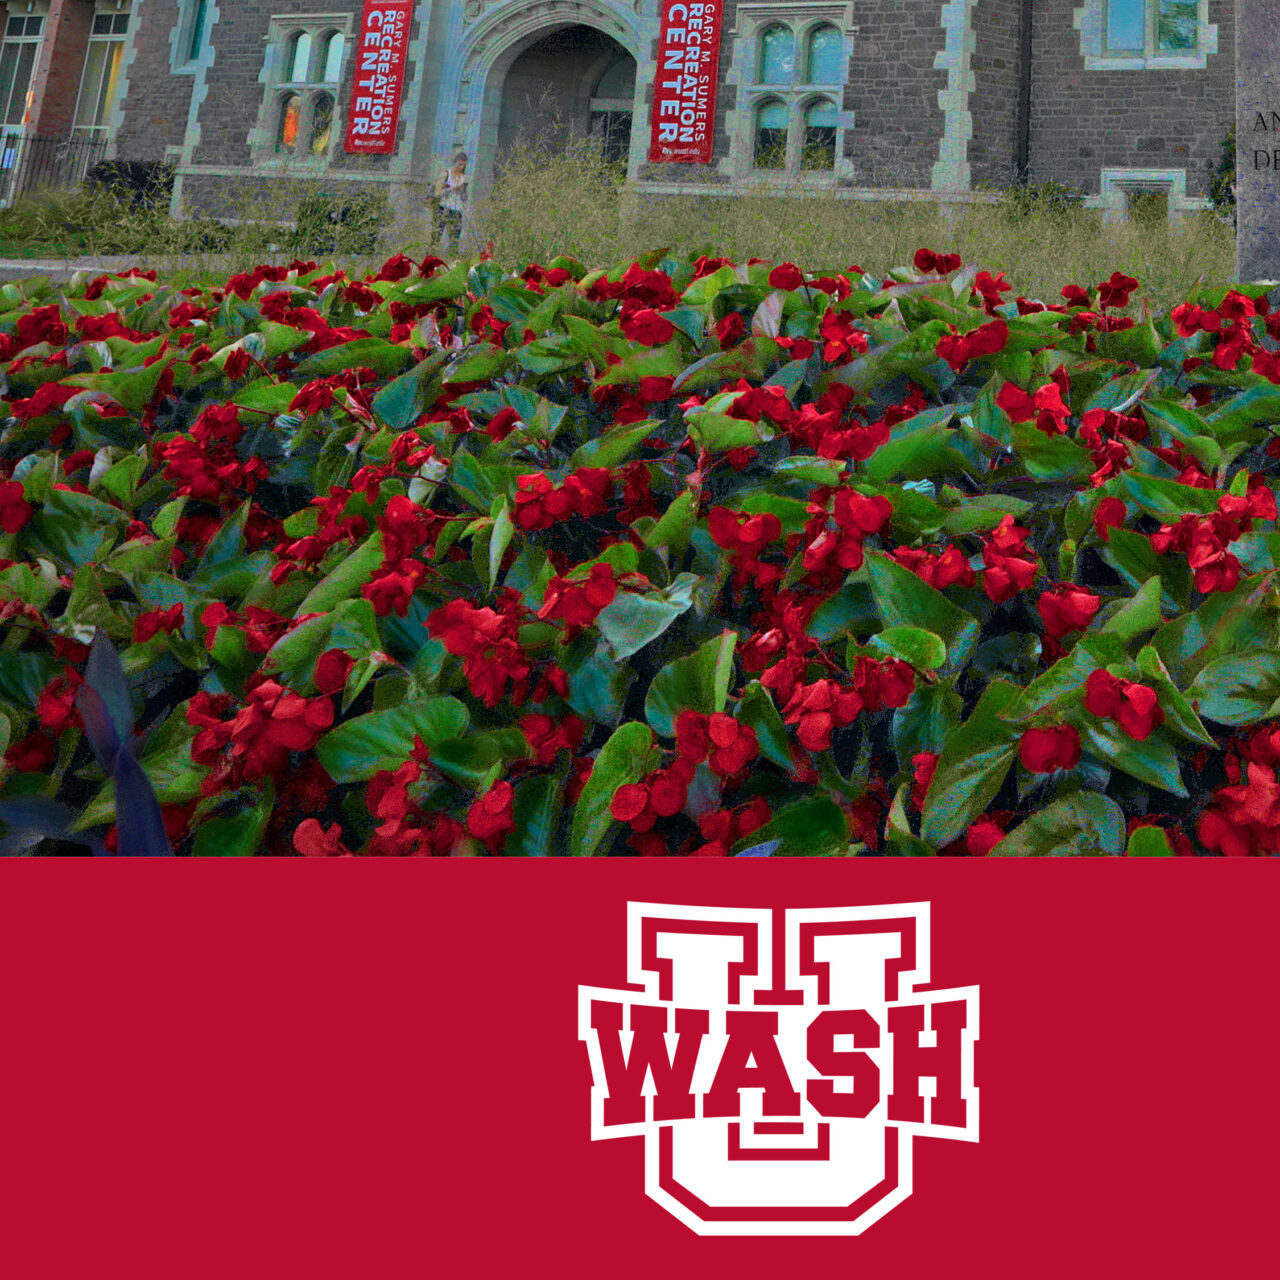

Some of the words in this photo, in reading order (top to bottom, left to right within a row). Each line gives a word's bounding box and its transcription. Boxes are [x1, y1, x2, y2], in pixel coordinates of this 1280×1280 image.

[393, 11, 405, 47] GARY
[702, 3, 715, 44] GARY
[352, 10, 384, 135] CENTER
[368, 10, 397, 135] RECREATION
[389, 52, 399, 68] M.
[658, 3, 688, 142] CENTER
[679, 3, 704, 142] RECREATION
[700, 51, 711, 68] M.
[381, 75, 397, 134] SUMERS
[695, 75, 709, 141] SUMERS
